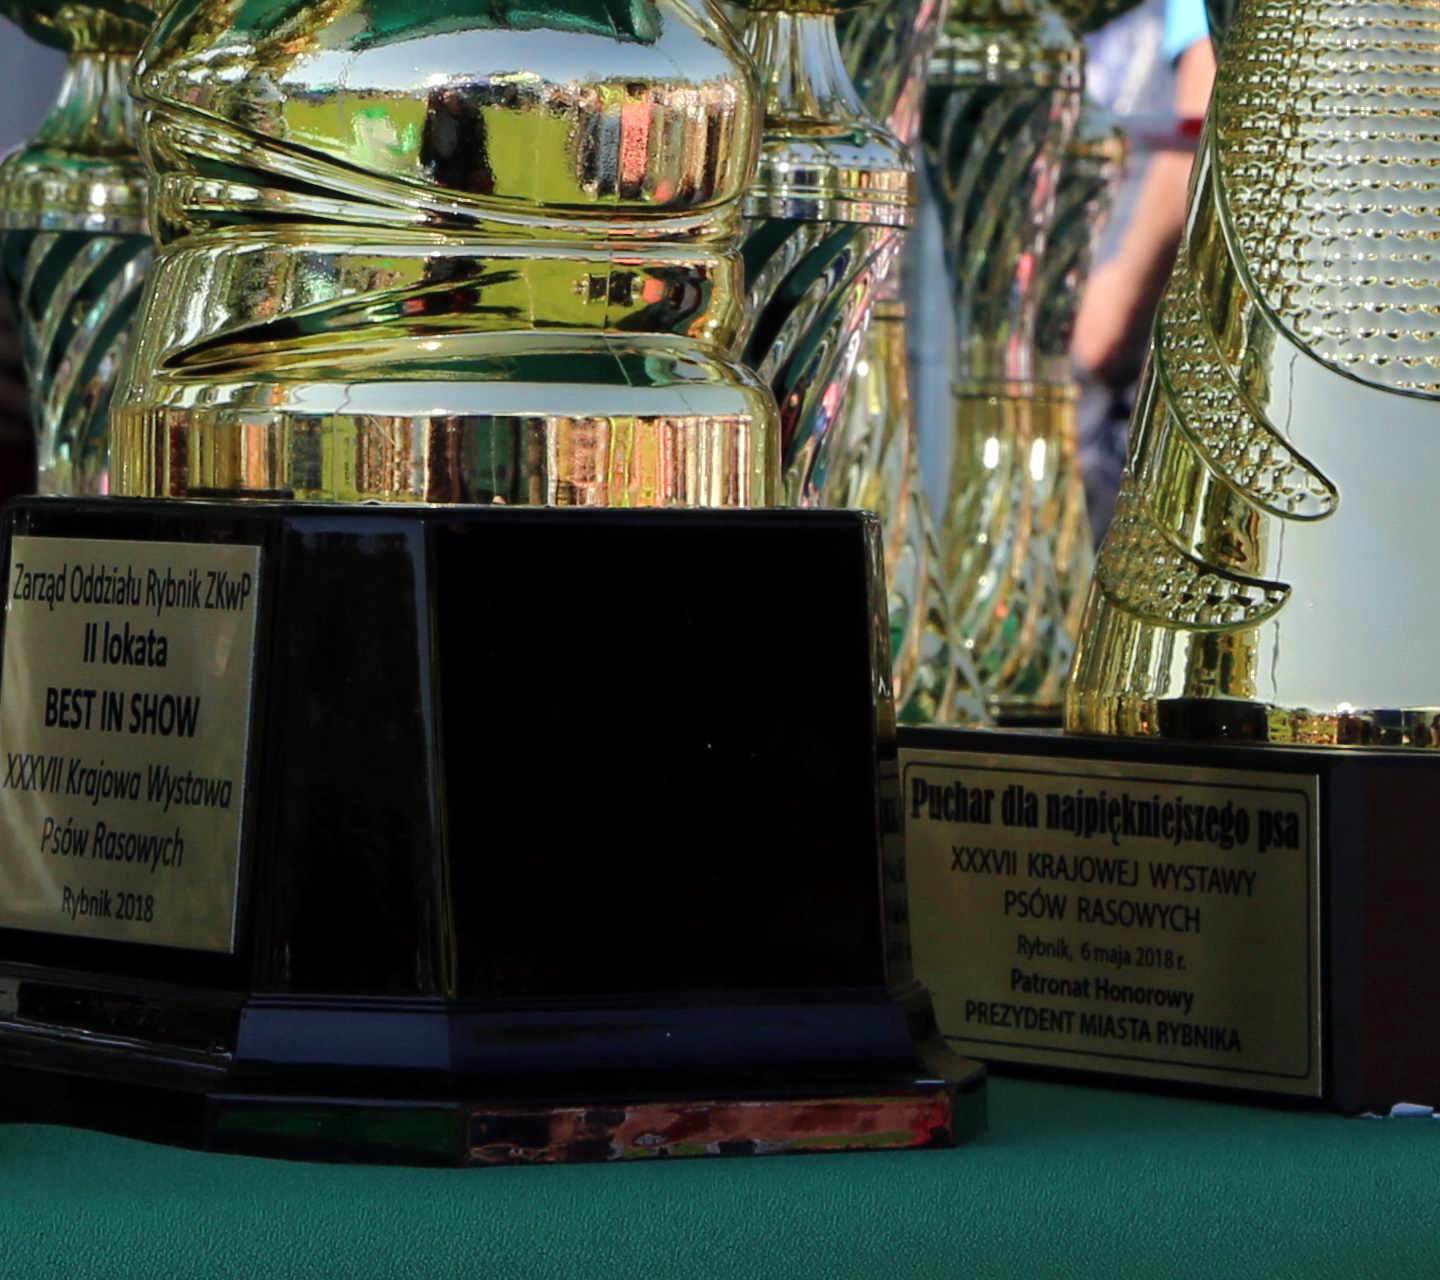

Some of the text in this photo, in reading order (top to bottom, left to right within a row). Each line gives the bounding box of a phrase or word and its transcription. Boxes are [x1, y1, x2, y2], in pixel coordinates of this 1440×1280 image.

[13, 562, 252, 617] Zarząd Oddziału Rybnik ZKwP
[83, 620, 168, 668] II lokata
[44, 687, 201, 738] BEST IN SHOW
[3, 752, 233, 813] XXXVII Krajowa Wystawa
[911, 777, 1301, 854] Puchar dla najpiękniejszego psa
[40, 816, 185, 874] Psów Rasowych
[951, 845, 1257, 898] XXXVII KRAJOWEJ WYSTAWY
[61, 886, 154, 923] Rybnik 2018
[1004, 887, 1200, 933] PSÓW RASOWYCH
[1017, 934, 1186, 971] Rybnik, 6 maja 2018 r.
[1011, 968, 1194, 1016] Patronat Honorowy
[965, 999, 1242, 1053] PREZYDENT MIASTA RYBNIKA
